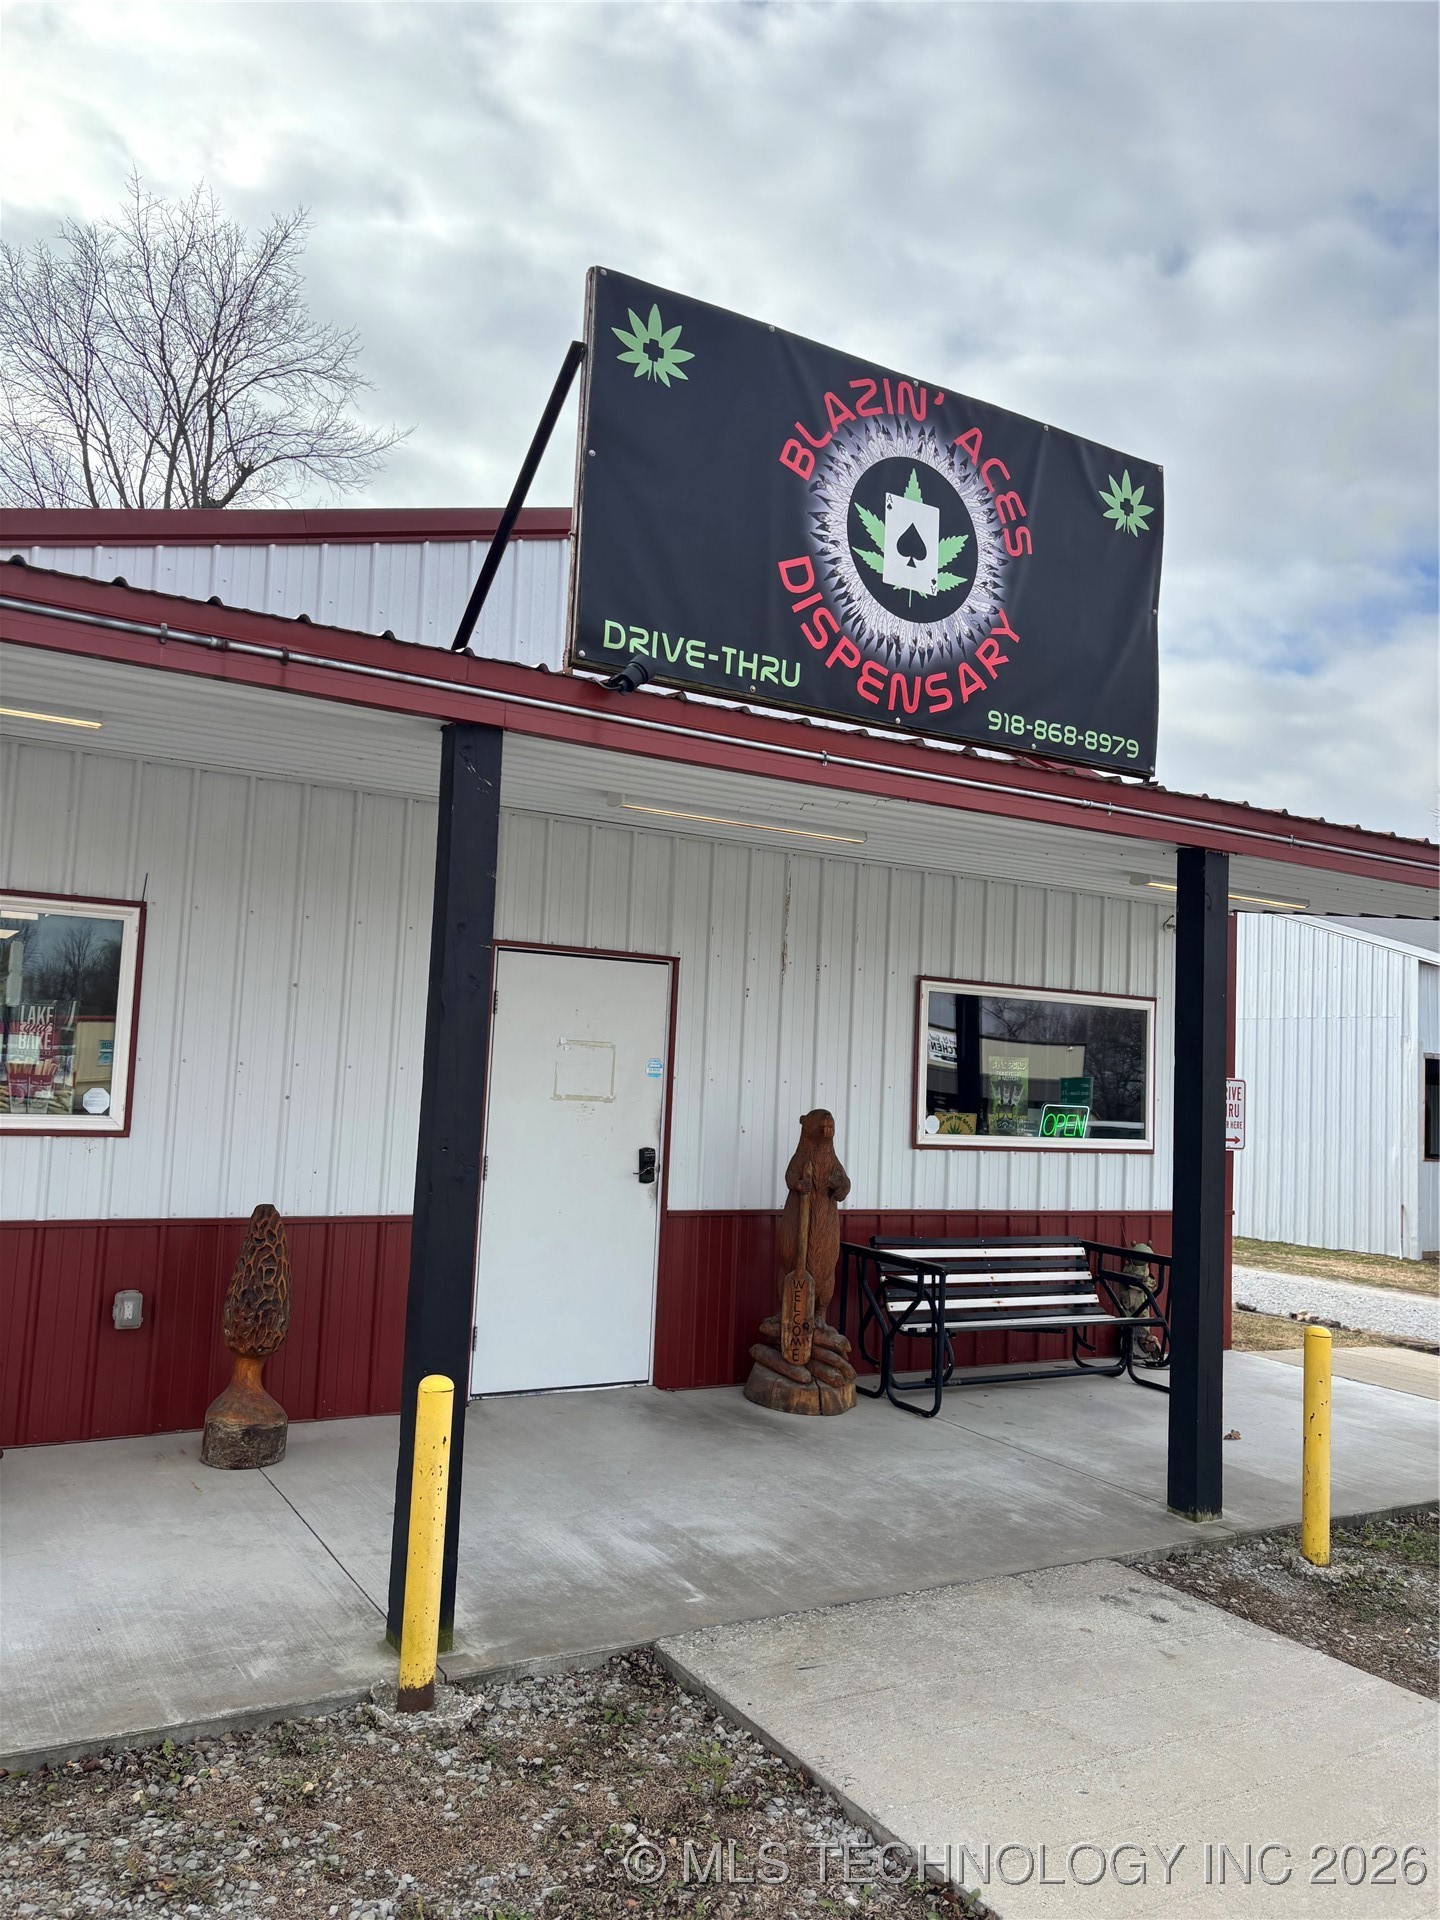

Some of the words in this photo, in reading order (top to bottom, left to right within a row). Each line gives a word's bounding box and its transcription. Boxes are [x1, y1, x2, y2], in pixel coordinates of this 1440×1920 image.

[779, 378, 944, 481] BLAZIN'
[953, 427, 1033, 558] ACES
[603, 619, 801, 688] DRIVE-THRU
[778, 555, 1020, 714] DISPENSARY
[987, 710, 1140, 759] 918-868-8979
[20, 1005, 54, 1025] LAKE
[18, 1031, 52, 1050] BAKE
[1226, 1086, 1242, 1101] IVE
[1043, 1113, 1086, 1136] OPEN
[791, 1279, 805, 1362] WELCOME
